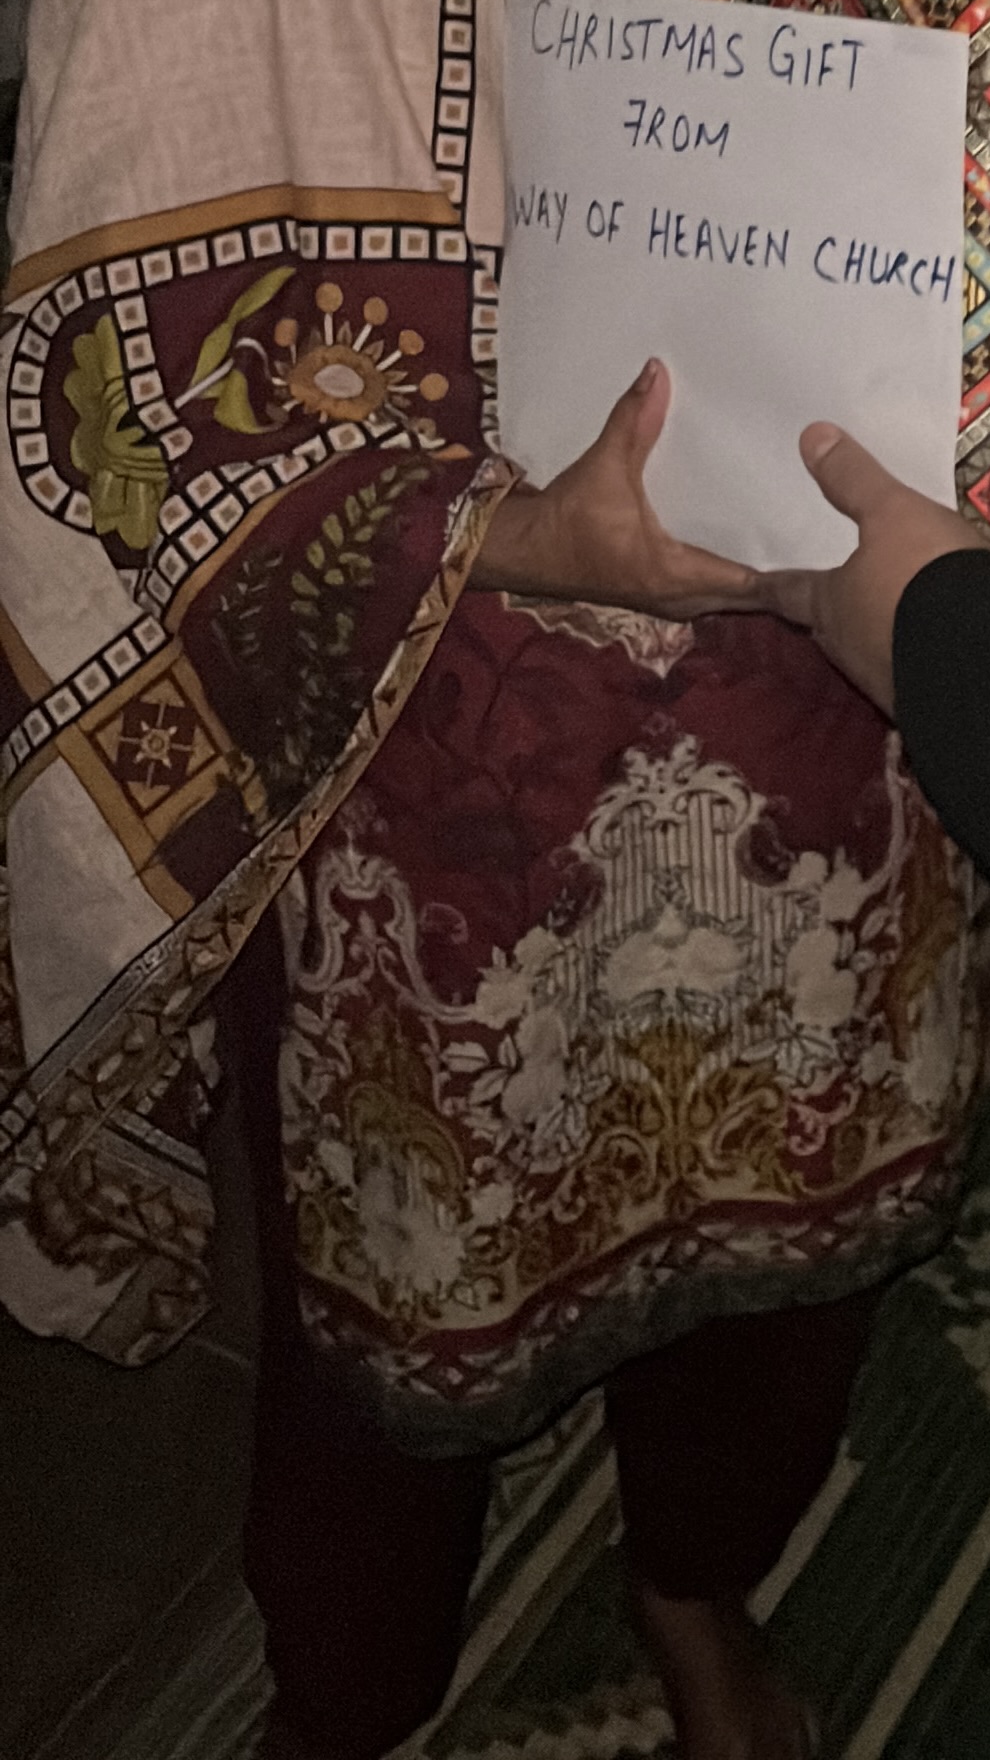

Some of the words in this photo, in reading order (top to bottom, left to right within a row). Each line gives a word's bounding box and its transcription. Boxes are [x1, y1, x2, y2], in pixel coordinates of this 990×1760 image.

[768, 24, 865, 90] GIFT
[513, 184, 568, 243] WAY
[586, 199, 625, 242] OF
[648, 206, 790, 268] HEAVEN
[814, 236, 959, 303] CHURCH
